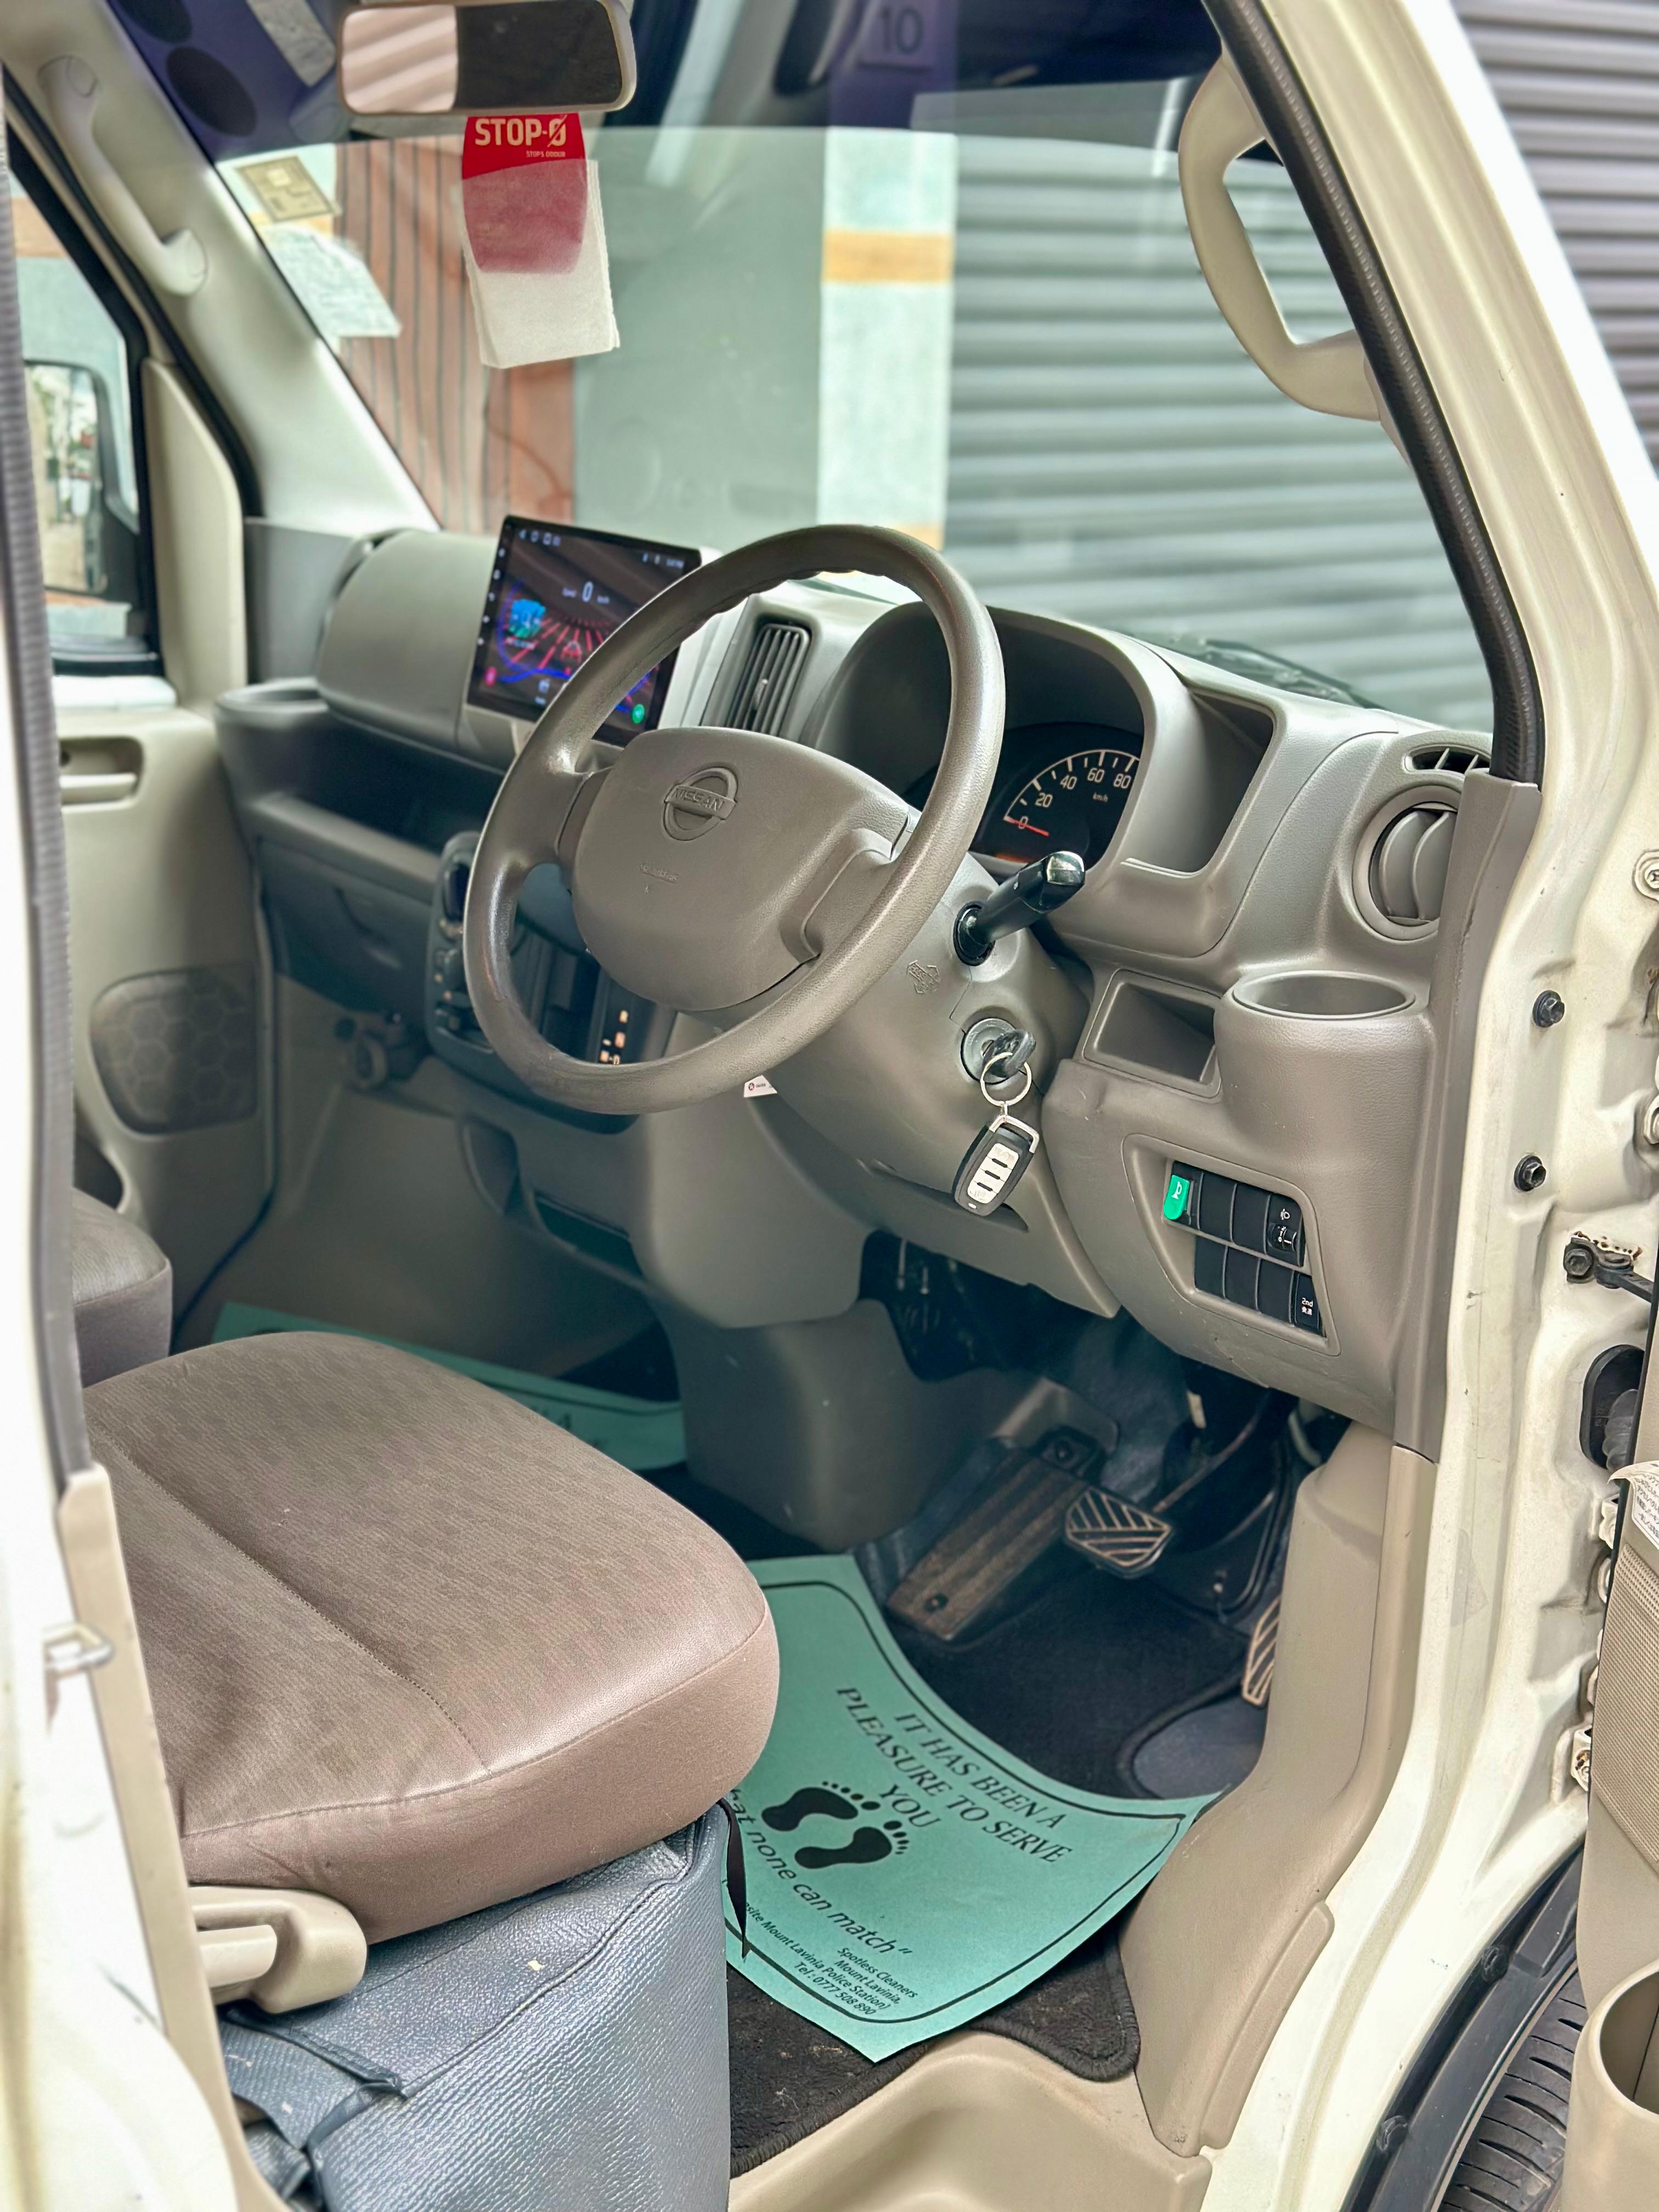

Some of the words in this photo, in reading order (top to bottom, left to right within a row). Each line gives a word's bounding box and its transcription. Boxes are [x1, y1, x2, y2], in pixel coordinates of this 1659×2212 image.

[880, 6, 923, 54] 10
[1059, 775, 1077, 790] 40
[1087, 768, 1105, 782] 60
[1113, 774, 1131, 789] 80
[674, 788, 725, 812] NISSAN
[1035, 793, 1053, 808] 20
[1092, 793, 1108, 802] km/h
[1018, 816, 1029, 830] 0
[1301, 1297, 1313, 1307] 2nd
[836, 1688, 952, 1797] PLEASURE
[946, 1795, 989, 1821] TO
[983, 1820, 1073, 1863] SERVE
[894, 1713, 931, 1733] IT
[919, 1737, 980, 1776] HAS
[970, 1776, 1047, 1818] BEEN
[1036, 1813, 1066, 1829] A
[879, 1784, 941, 1827] YOU
[730, 1788, 757, 1824] hat
[746, 1832, 797, 1879] none
[793, 1884, 832, 1911] can
[761, 1921, 794, 1945] Mount
[790, 1943, 825, 1969] Lavinia
[822, 1967, 852, 1988] Police
[849, 1985, 891, 2010] Station)
[834, 1960, 868, 1983] Mount
[837, 1948, 878, 1974] Spotless
[877, 1972, 918, 1998] Cleaners
[812, 1977, 841, 1992] 0777
[835, 1991, 859, 2005] 508
[854, 2002, 877, 2015] 890
